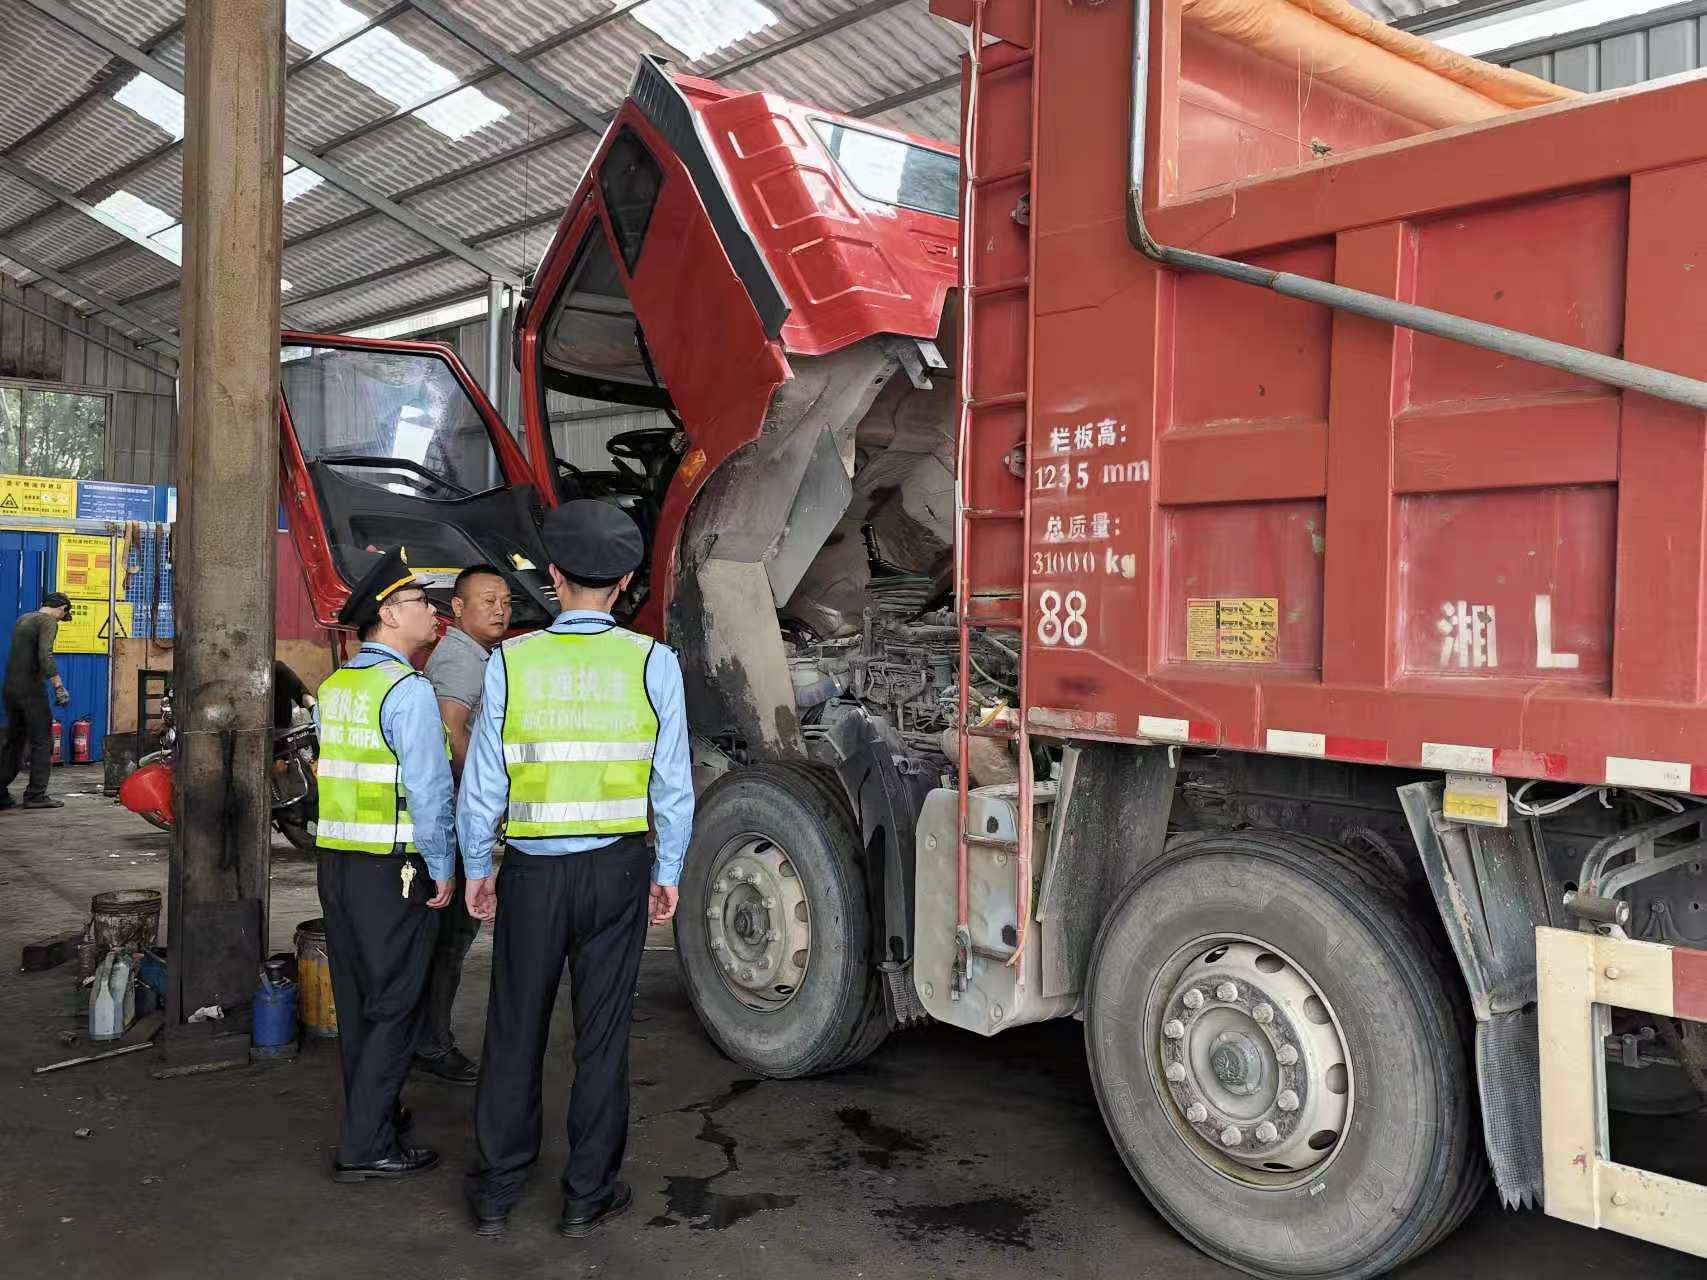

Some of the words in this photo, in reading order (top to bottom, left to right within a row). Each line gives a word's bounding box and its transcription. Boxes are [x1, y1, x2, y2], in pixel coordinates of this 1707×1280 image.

[1034, 462, 1089, 491] 1235
[1103, 460, 1151, 483] mm
[1032, 551, 1096, 576] 31000
[1105, 548, 1136, 578] kg
[1037, 589, 1089, 647] 88
[1438, 600, 1499, 669] 湘
[1535, 594, 1580, 669] L
